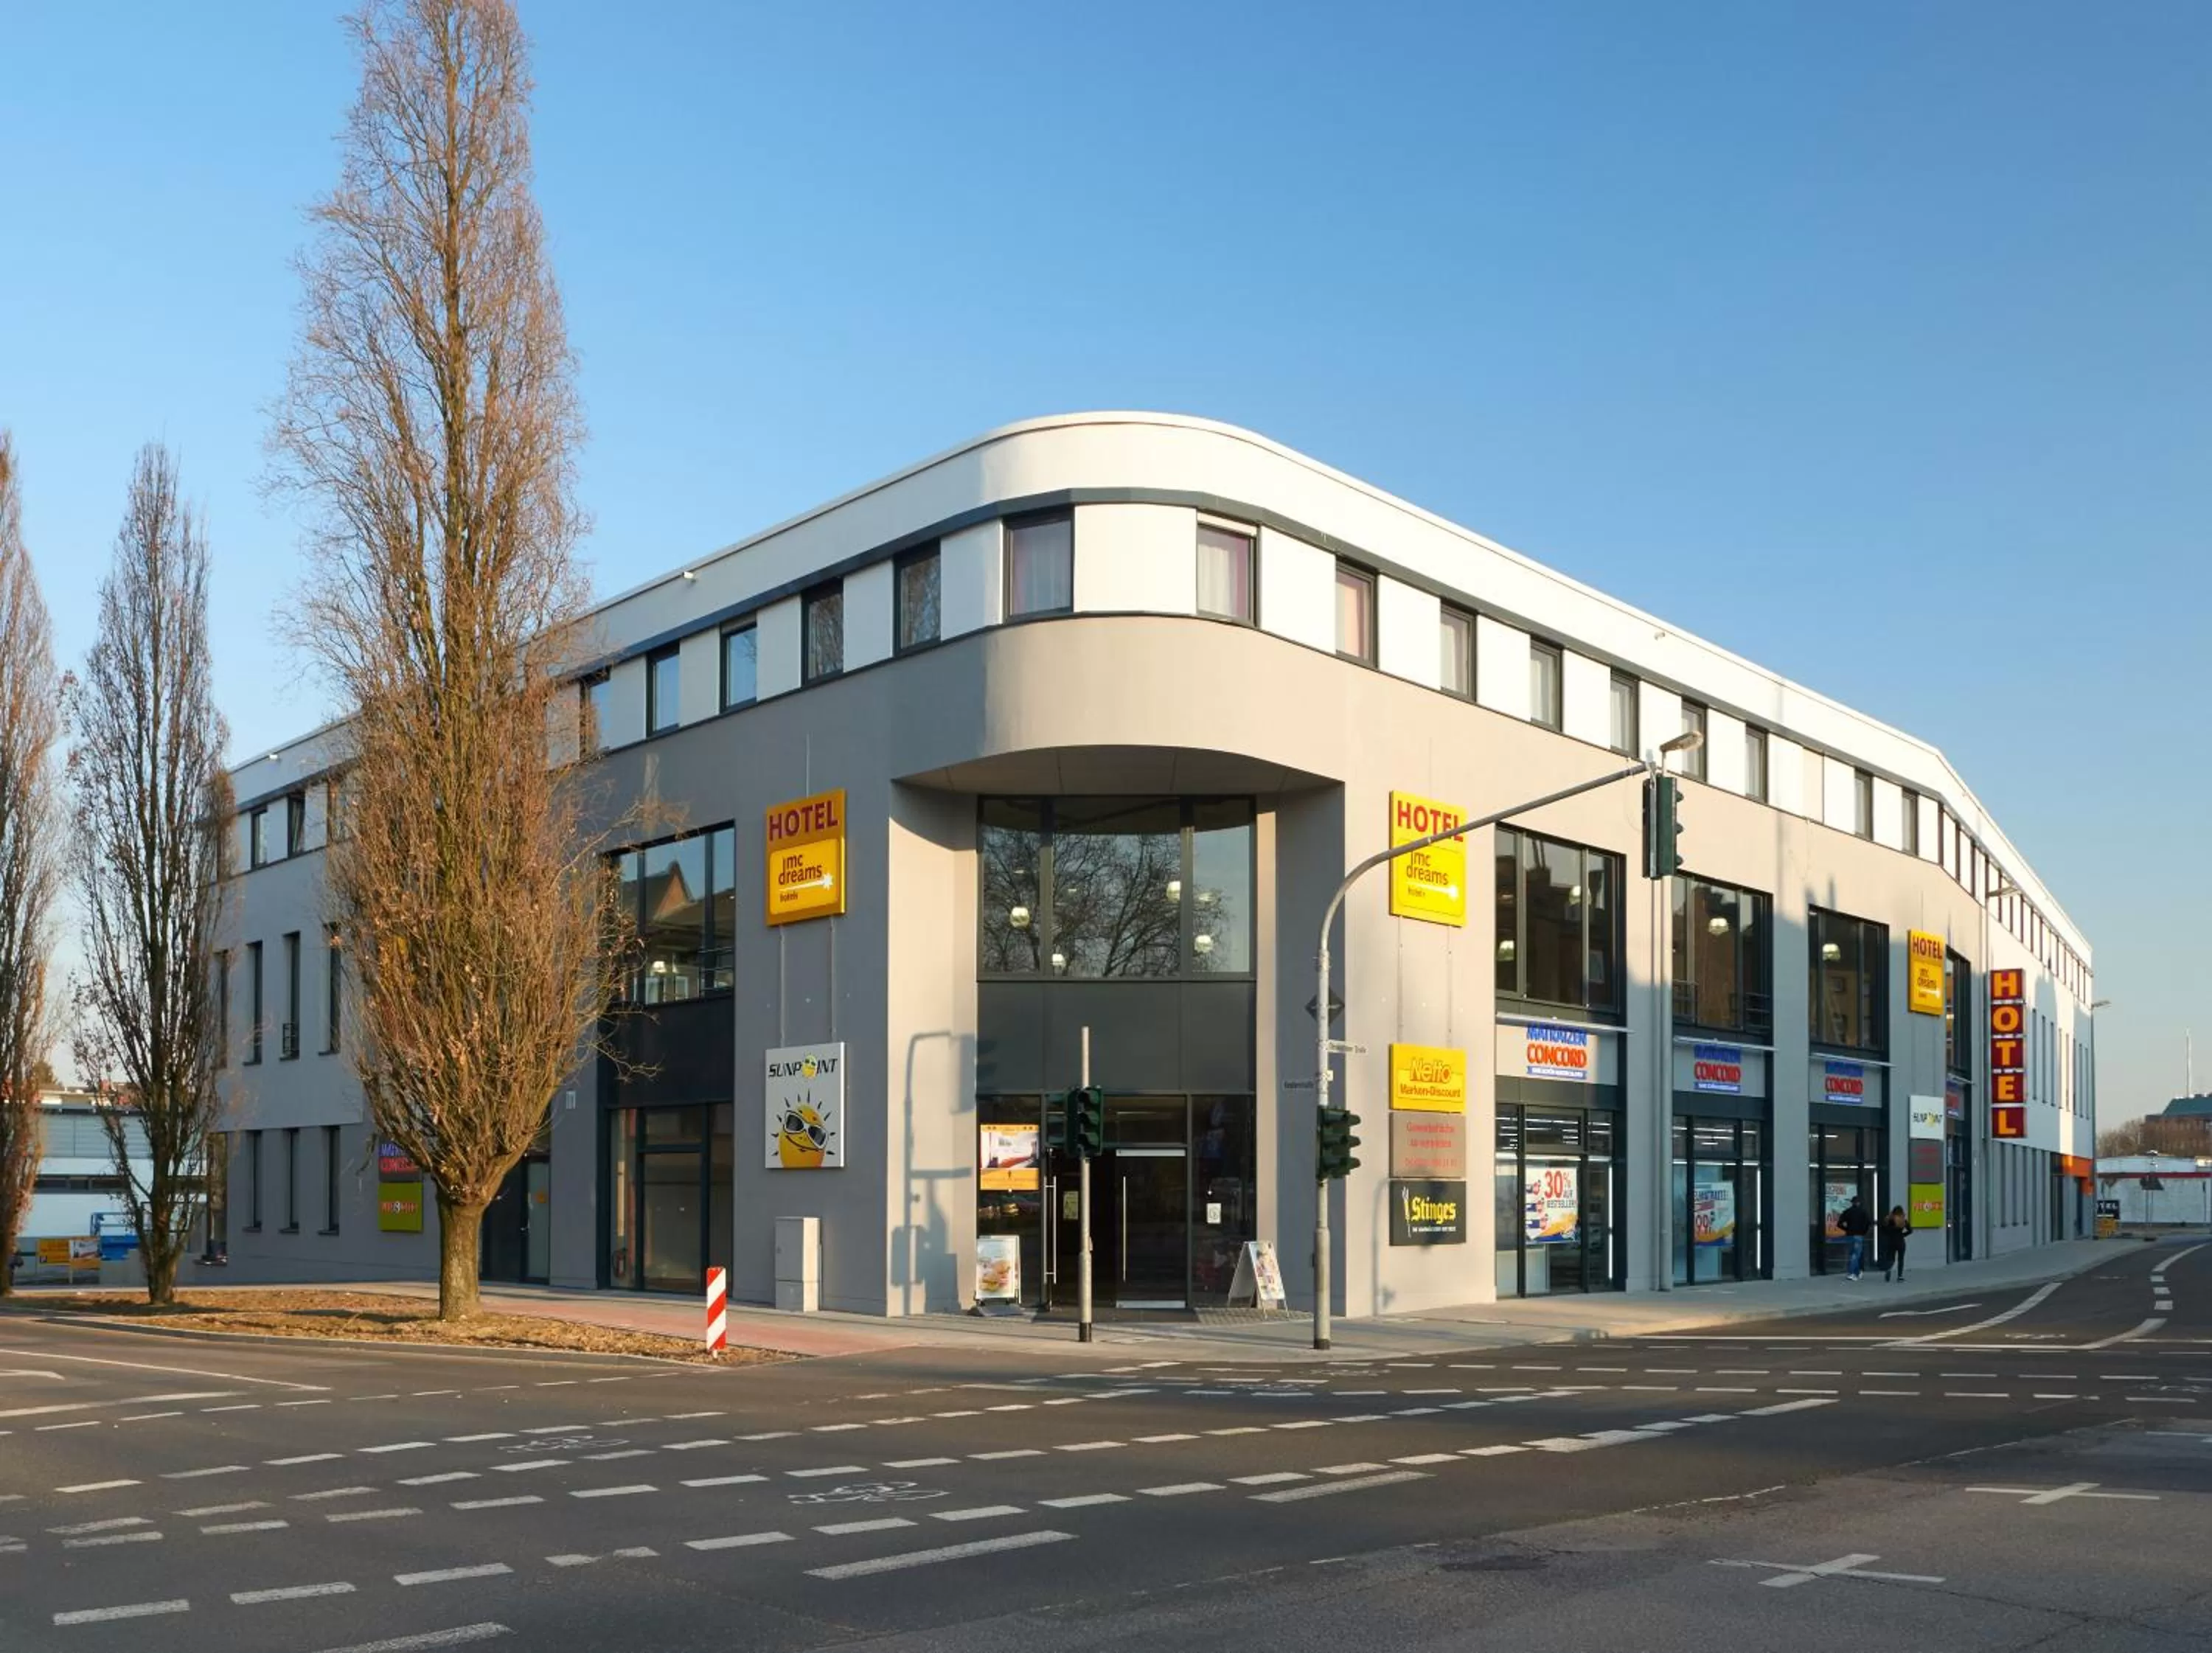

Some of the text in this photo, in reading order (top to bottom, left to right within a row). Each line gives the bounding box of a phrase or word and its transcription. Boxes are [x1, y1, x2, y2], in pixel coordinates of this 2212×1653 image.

[769, 800, 838, 841] HOTEL
[1397, 800, 1464, 842] HOTEL
[778, 857, 823, 885] dreams
[786, 854, 803, 869] mc
[1406, 853, 1449, 885] dreams
[1912, 935, 1943, 960] HOTEL
[1527, 1043, 1587, 1068] CONCORD
[1992, 971, 2020, 1135] HOTEL
[1410, 1056, 1451, 1084] Netto
[1694, 1062, 1742, 1083] CONCORD
[1400, 1083, 1461, 1098] Marken-Discount
[1411, 1195, 1456, 1224] Stinges
